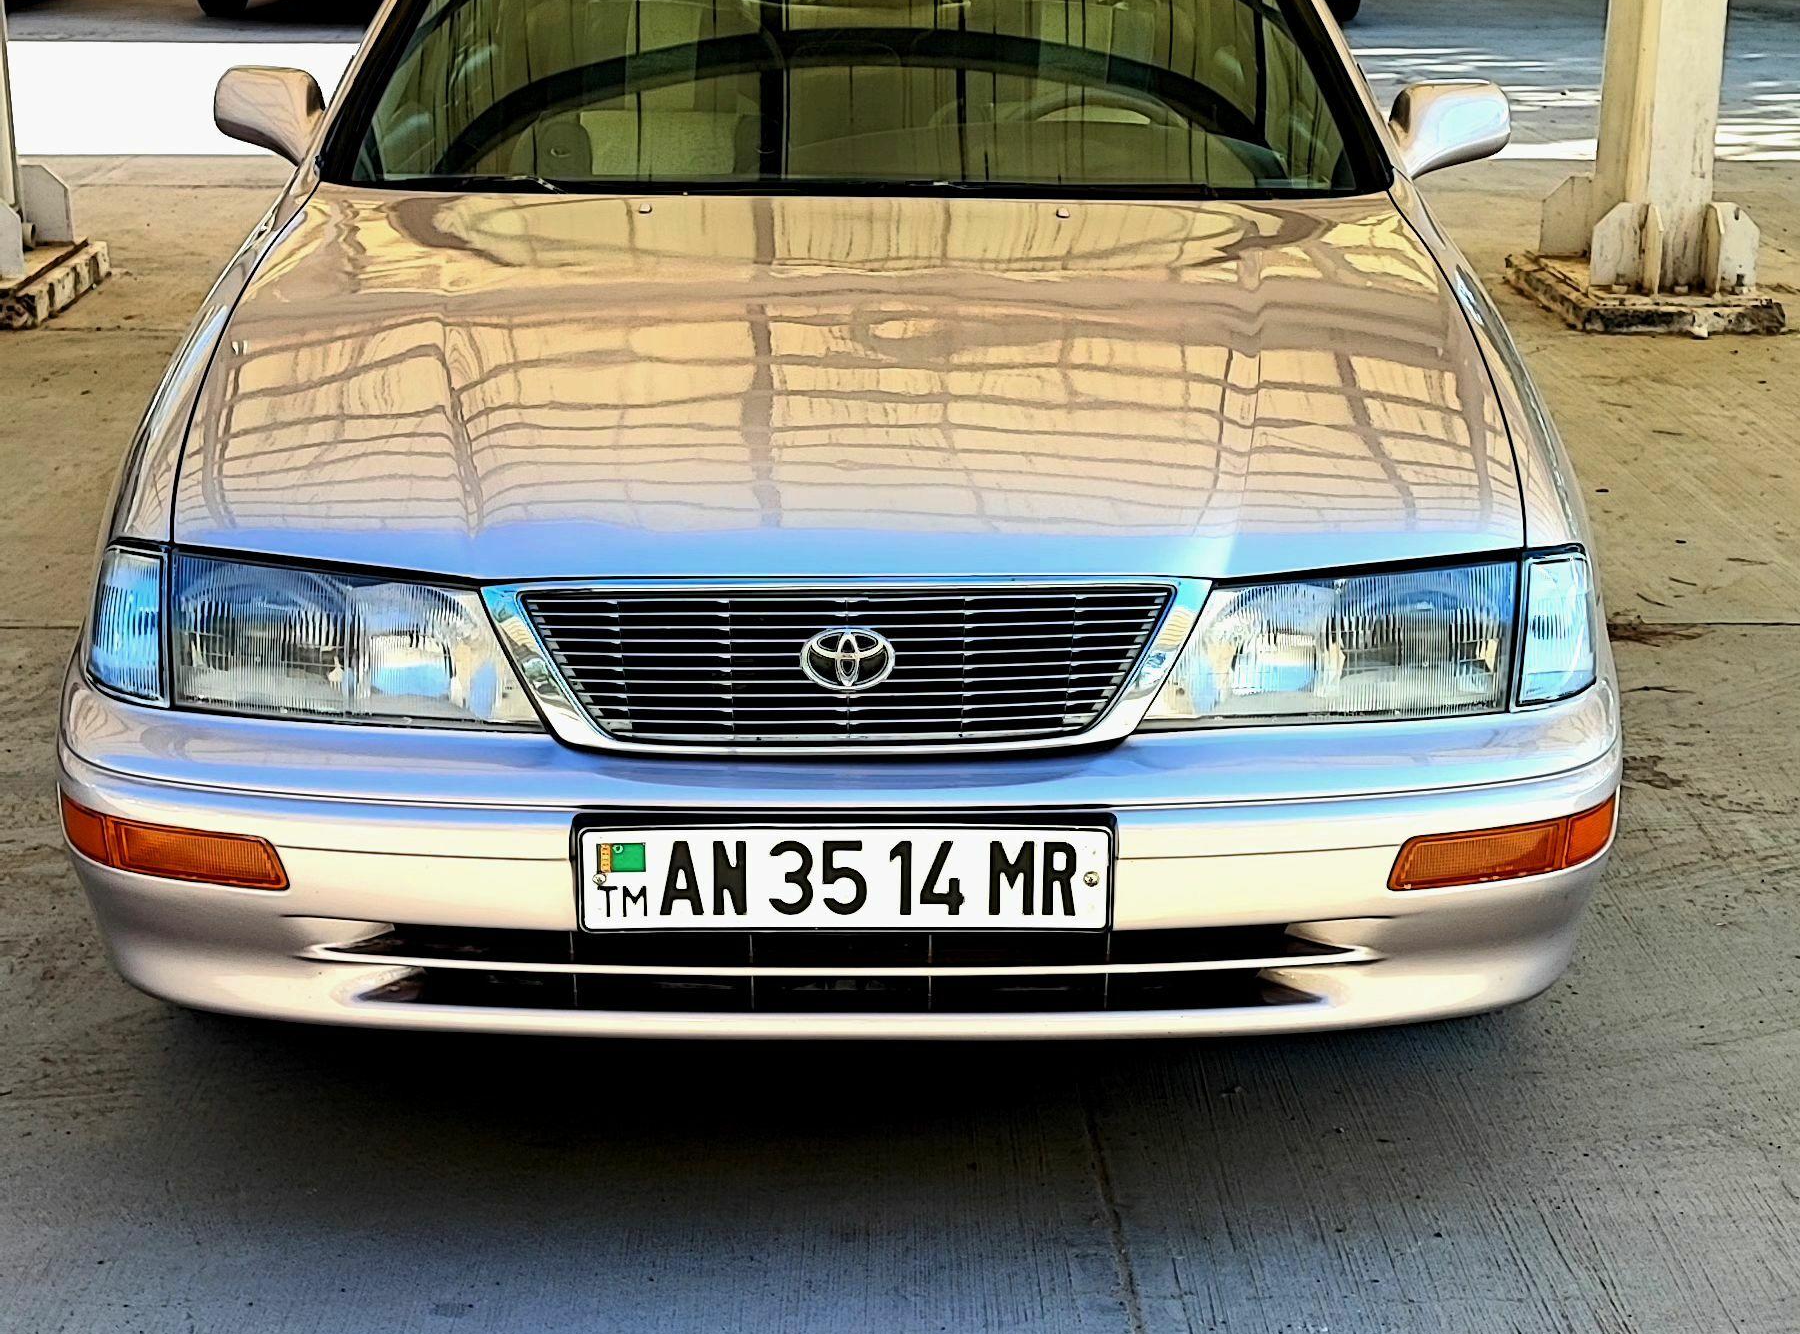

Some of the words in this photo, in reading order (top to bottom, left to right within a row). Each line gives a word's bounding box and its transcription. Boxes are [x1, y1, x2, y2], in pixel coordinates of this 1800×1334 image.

[600, 885, 648, 917] TM
[659, 840, 747, 916] AN
[769, 840, 868, 916] 35
[889, 840, 965, 916] 14
[988, 840, 1077, 917] MR
